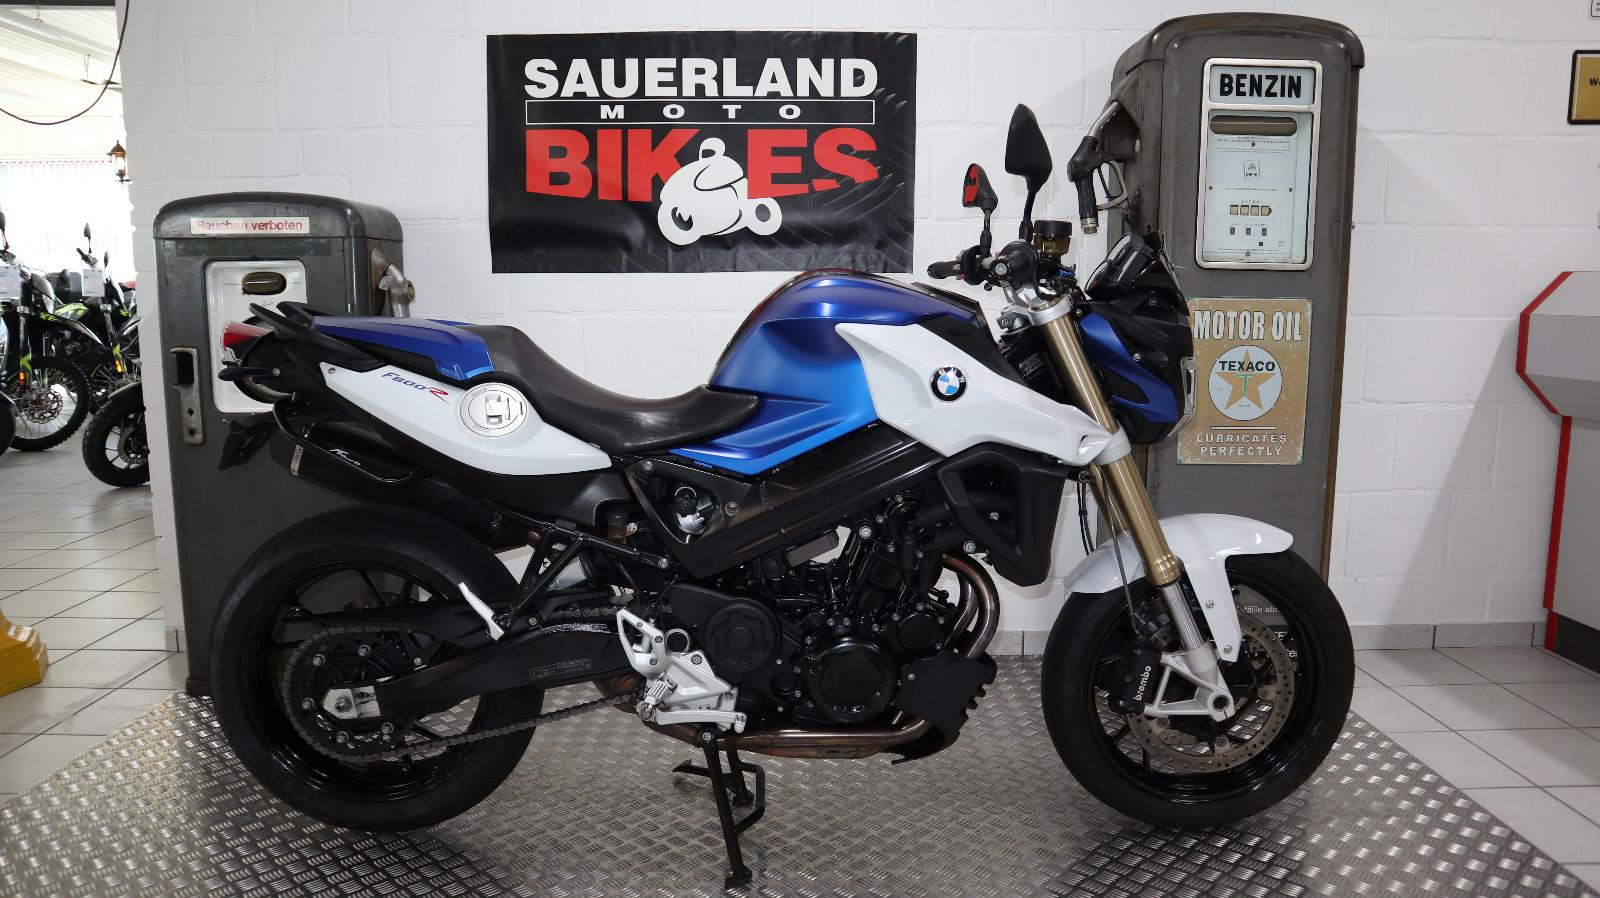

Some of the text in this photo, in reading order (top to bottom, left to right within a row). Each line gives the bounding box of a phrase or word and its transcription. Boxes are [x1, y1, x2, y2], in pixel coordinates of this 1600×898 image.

[524, 57, 878, 99] SAUERLAND
[1219, 73, 1302, 98] BENZIN
[600, 104, 802, 120] MOTO
[525, 127, 879, 203] BIKES
[197, 219, 303, 231] Rauchen verboten
[1193, 310, 1303, 341] MOTOR OIL
[1218, 360, 1276, 372] TEXACO
[1236, 373, 1255, 398] T
[1196, 432, 1289, 444] LUBRICATES
[1199, 446, 1283, 457] PERFECTLY
[1132, 665, 1151, 701] brembo
